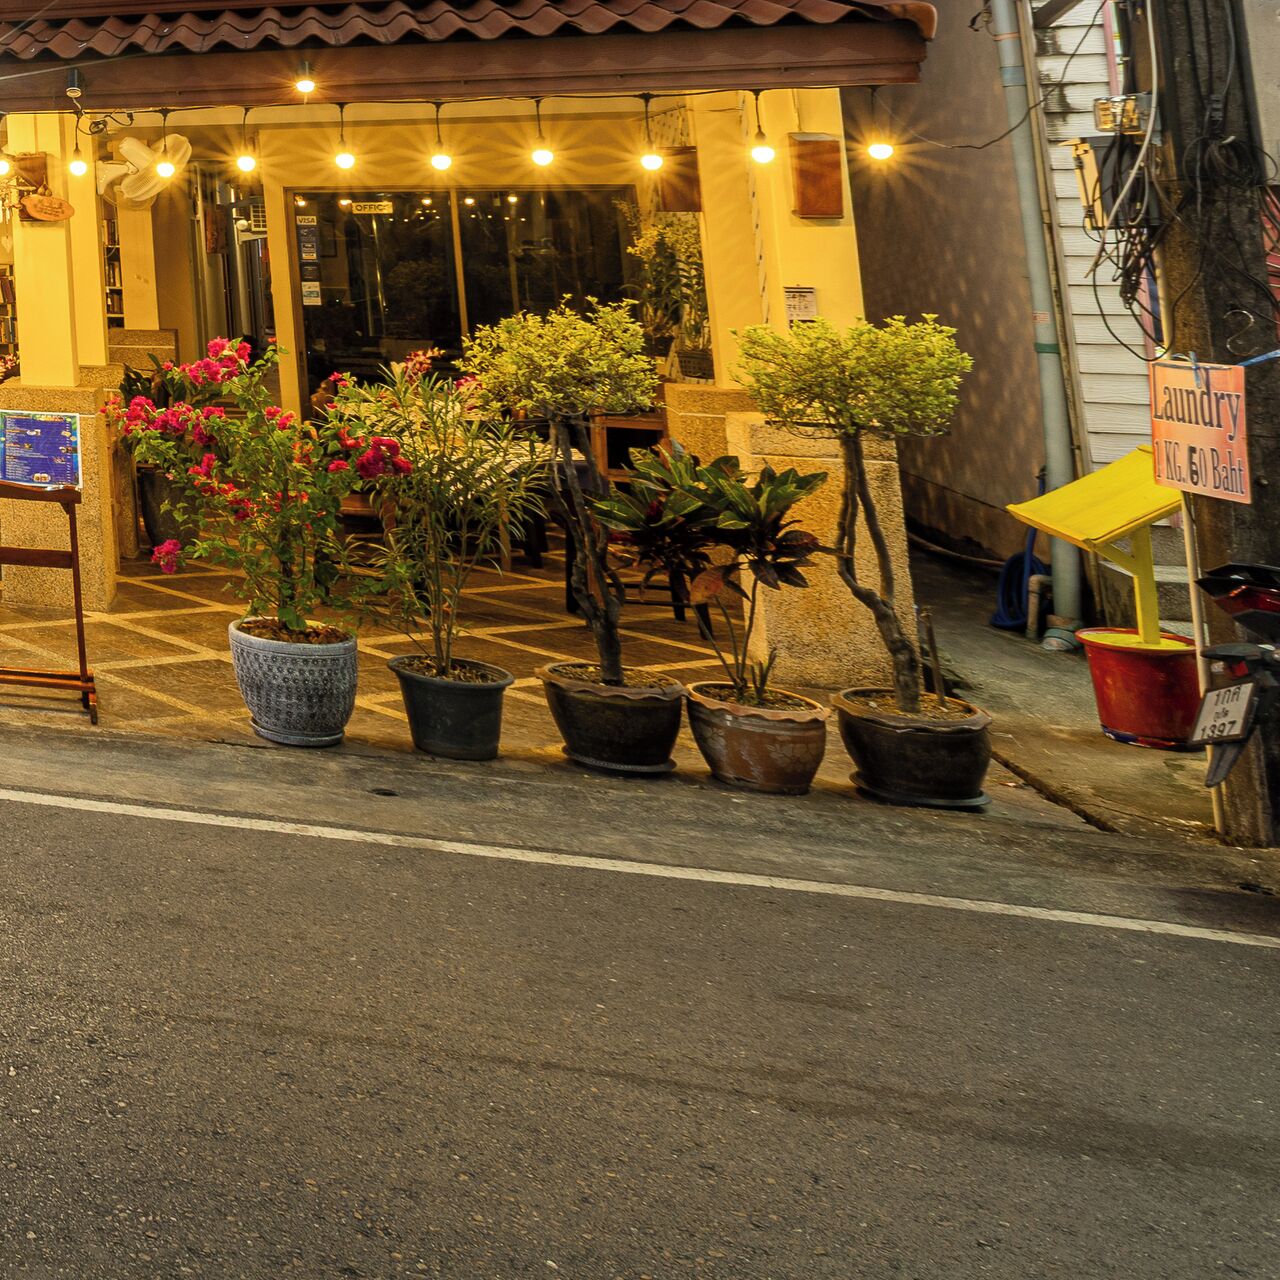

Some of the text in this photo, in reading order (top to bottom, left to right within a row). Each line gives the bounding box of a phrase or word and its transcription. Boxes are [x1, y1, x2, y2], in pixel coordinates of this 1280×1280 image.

[1152, 362, 1242, 442] Laundry
[1155, 440, 1161, 478] 1
[1210, 447, 1245, 495] Baht
